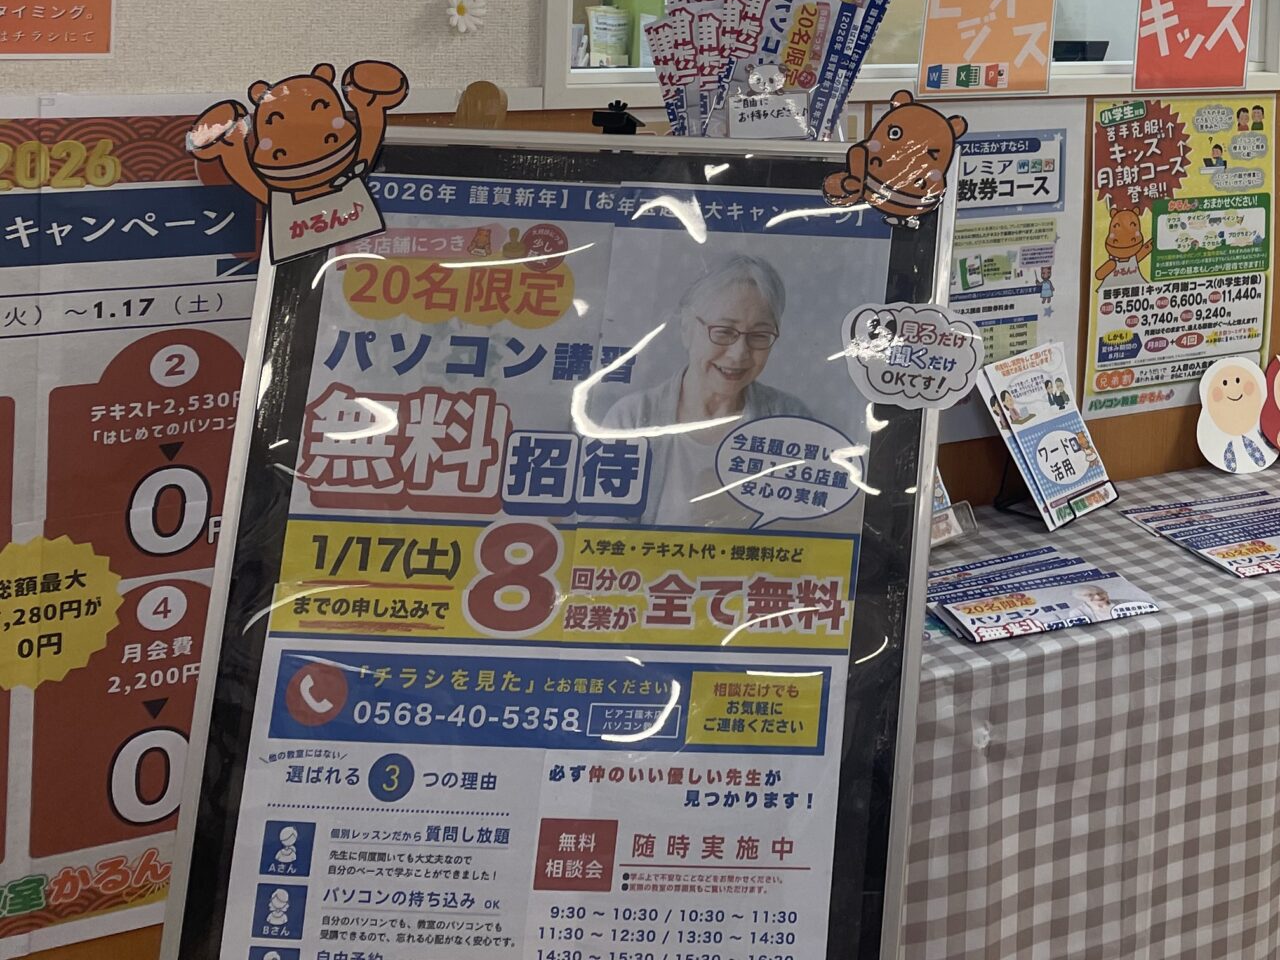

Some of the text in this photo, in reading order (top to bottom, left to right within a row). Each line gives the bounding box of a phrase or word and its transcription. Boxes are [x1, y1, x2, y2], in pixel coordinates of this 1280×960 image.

[1106, 119, 1164, 142] 苦手克服!
[962, 141, 1029, 154] スに活かすなら!
[1110, 132, 1165, 164] キッズ
[963, 159, 1014, 177] レミア
[1097, 156, 1185, 189] 月謝コース
[957, 176, 1051, 202] 数券コース
[1127, 182, 1167, 204] 登場!!
[4, 209, 235, 248] キャンペーン
[349, 259, 566, 319] 20名限定
[899, 319, 967, 350] 見るだけ
[324, 329, 639, 385] パソコン講習
[880, 370, 946, 394] OKです!
[300, 384, 643, 501] 無料 招待
[1037, 438, 1073, 463] ワード
[1049, 457, 1077, 482] 活用
[740, 480, 828, 507] 安心の実績
[311, 533, 461, 581] 1/17(土)
[579, 539, 805, 563] 入学金・テキスト代・授業料など
[466, 521, 560, 633] 8
[571, 567, 642, 593] 回分の
[292, 594, 450, 620] までの申し込みで
[644, 572, 846, 632] 全て無料
[563, 603, 637, 631] 授業が
[17, 632, 63, 660] 0円
[121, 636, 194, 666] 月会費
[712, 681, 801, 699] 相談だけでも
[353, 699, 582, 733] 0568-40-5358
[725, 700, 784, 717] お気軽に
[702, 716, 805, 735] ご連絡ください
[285, 764, 361, 786] 選ばれる
[422, 770, 498, 791] つの理由
[549, 764, 782, 787] 必ず仲のいい優しい先生が
[683, 789, 814, 810] 見つかります!
[558, 832, 597, 853] 無料
[631, 833, 794, 862] 随時実施中
[268, 863, 297, 875] Aさん
[329, 849, 473, 866] 先生に何度聞いても大丈夫なので
[544, 859, 604, 880] 相談会
[322, 886, 476, 909] パソコンの持ち込み
[550, 905, 799, 925] 9:30 10:30 10:30 11:30
[262, 926, 290, 937] Bさん
[537, 926, 796, 946] 11:30 12:30 13:30 14:30
